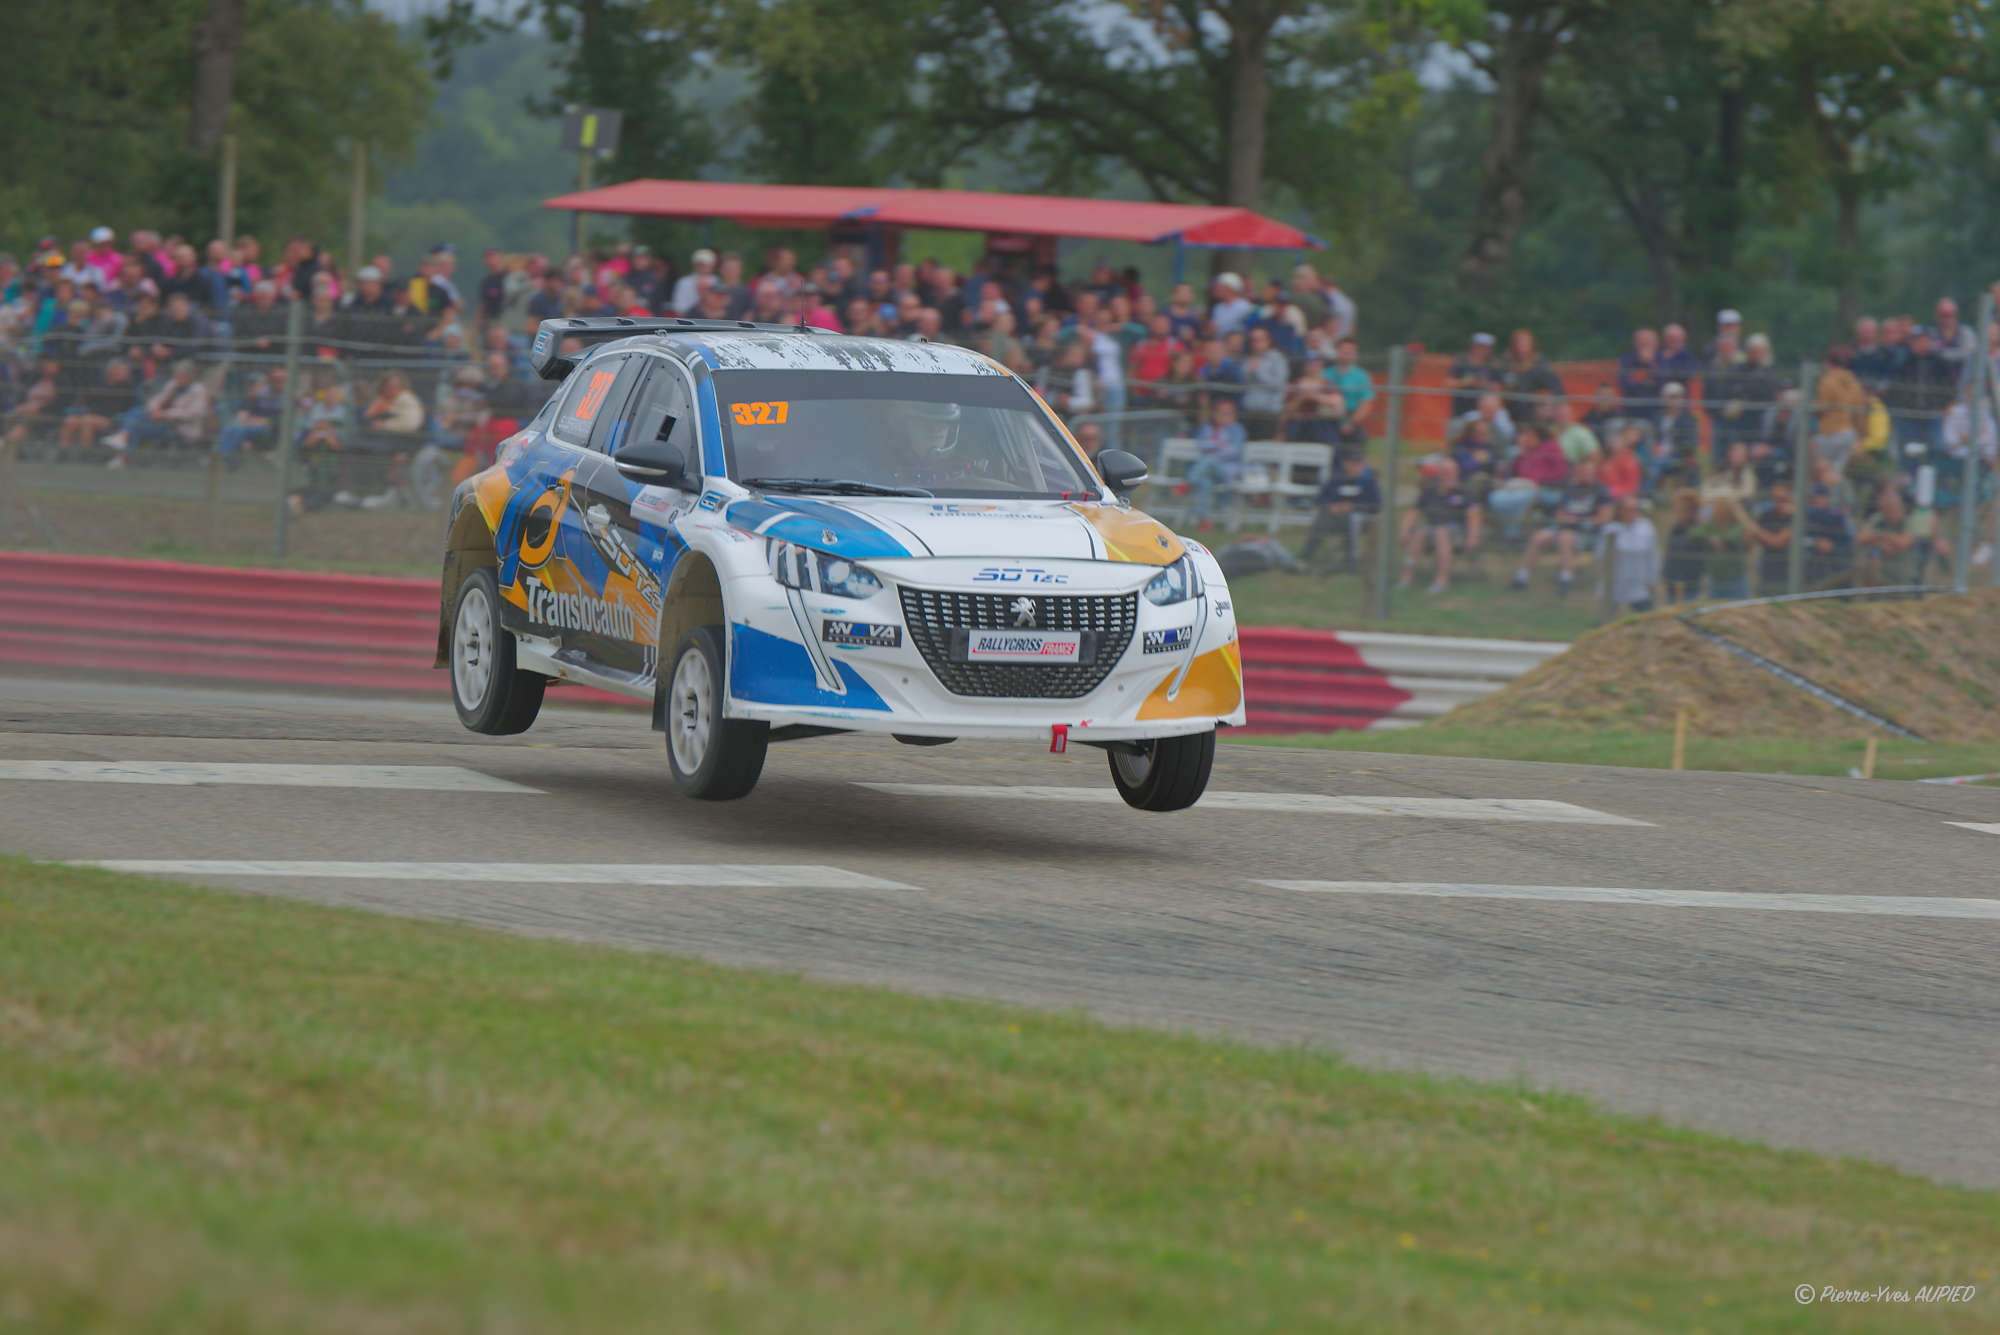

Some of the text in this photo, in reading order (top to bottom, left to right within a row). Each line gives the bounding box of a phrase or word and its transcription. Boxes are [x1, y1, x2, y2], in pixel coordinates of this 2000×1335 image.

[731, 401, 789, 425] 327
[526, 576, 635, 641] Translocauto
[978, 637, 1076, 656] RALLYCROSS FRANCE
